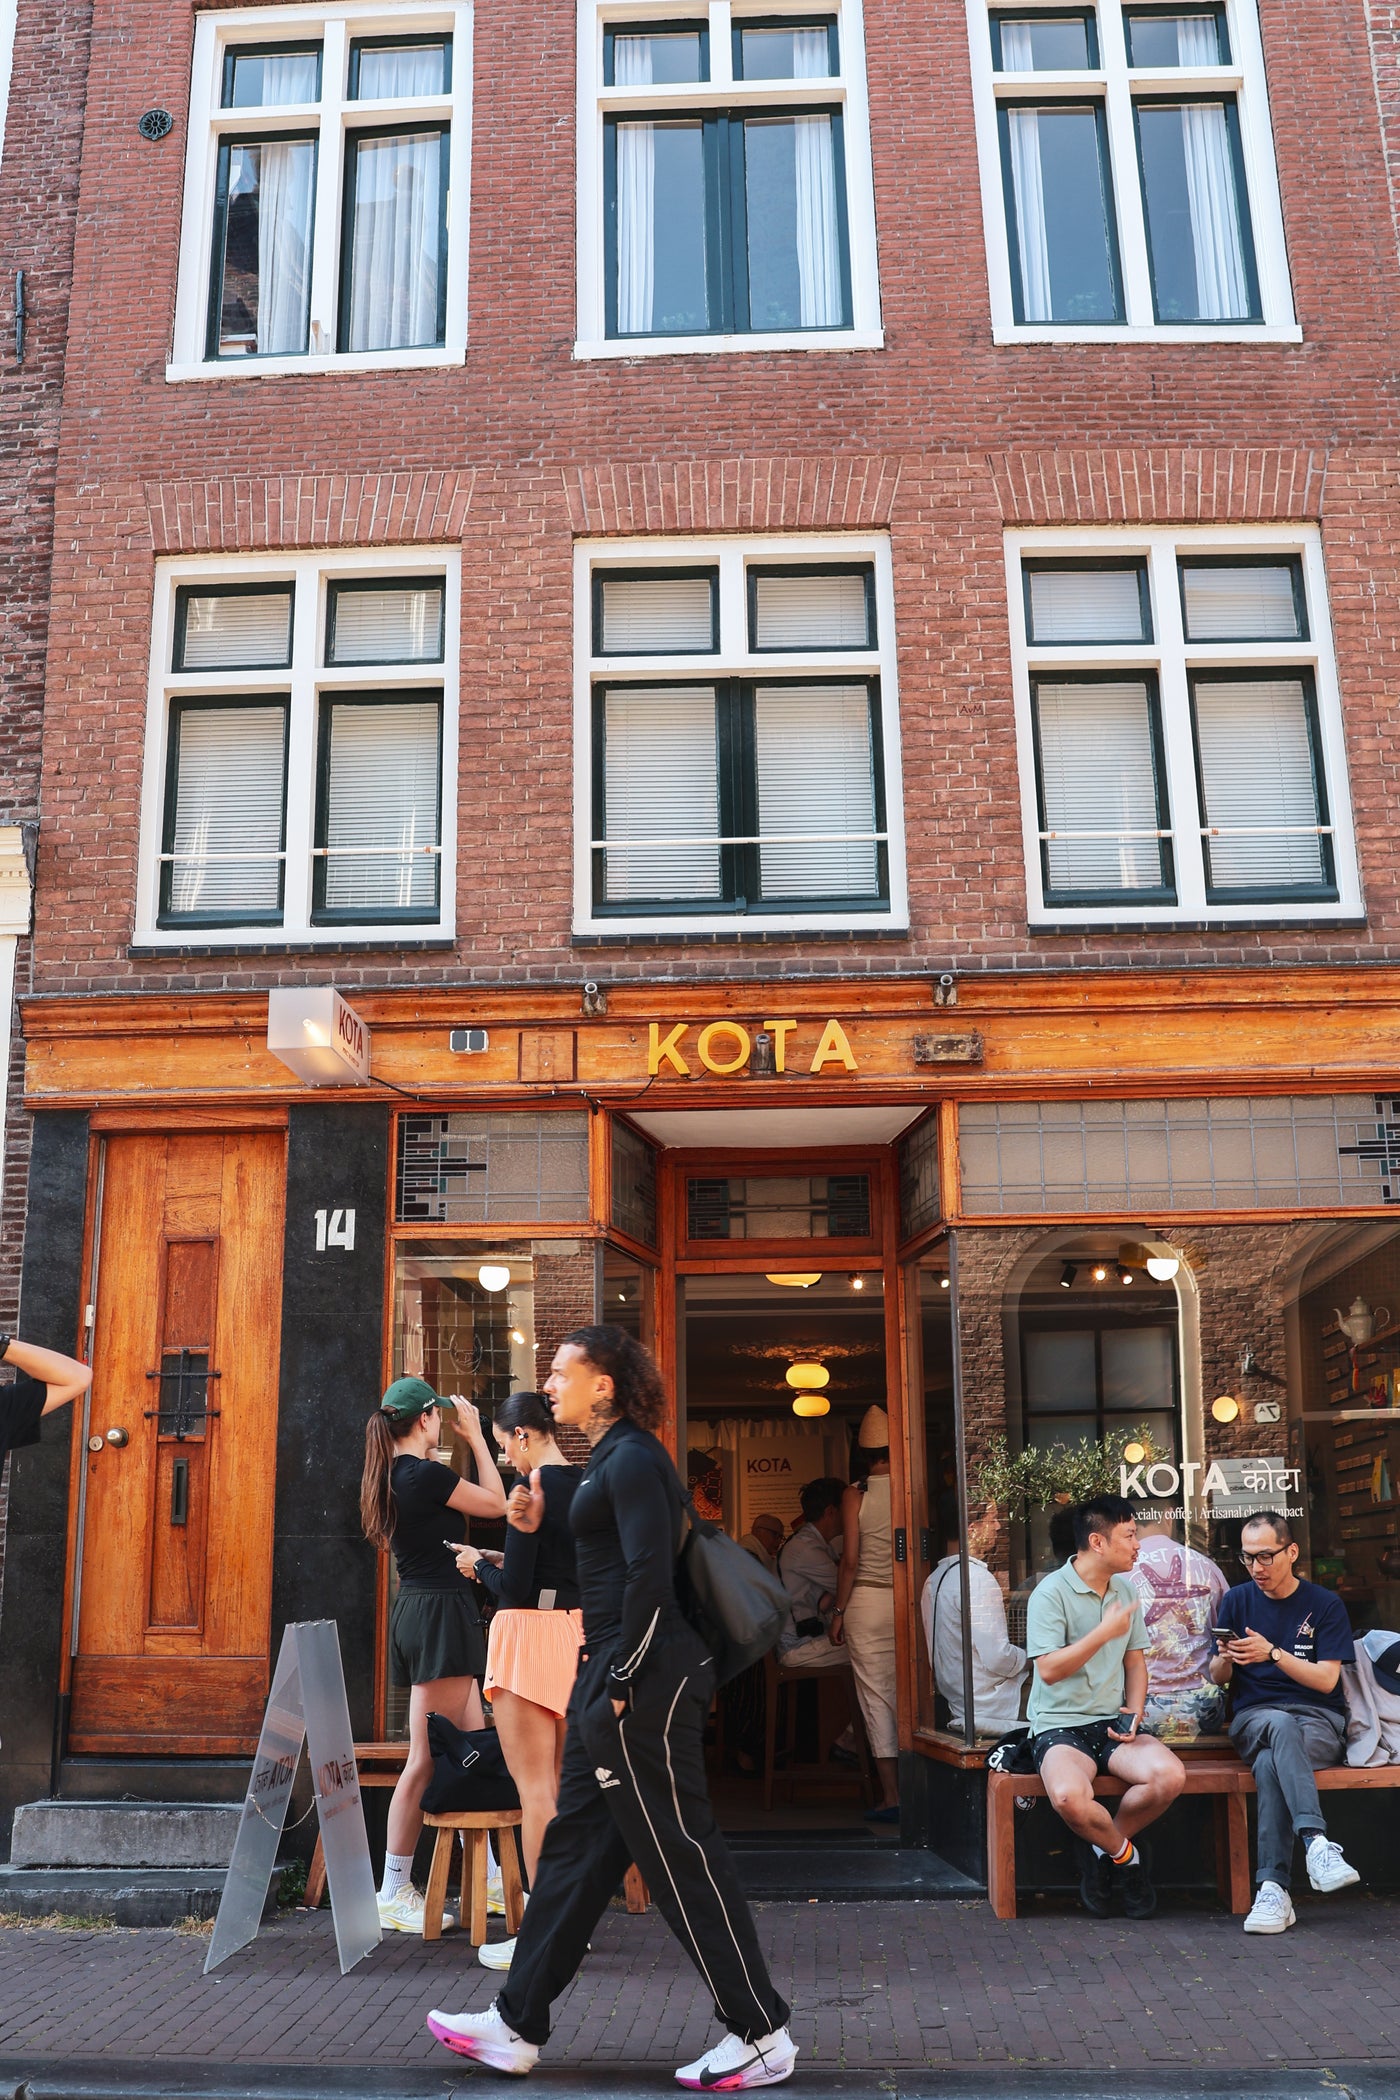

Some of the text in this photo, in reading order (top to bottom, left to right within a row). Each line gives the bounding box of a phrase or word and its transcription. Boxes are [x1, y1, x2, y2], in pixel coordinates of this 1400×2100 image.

[338, 1004, 363, 1059] KOTA
[648, 1019, 859, 1075] KOTA
[314, 1209, 356, 1251] 14
[747, 1458, 792, 1473] KOTA
[1119, 1459, 1301, 1499] KOTA कोटा
[1164, 1507, 1192, 1520] coffee
[1200, 1506, 1241, 1520] Artisanal
